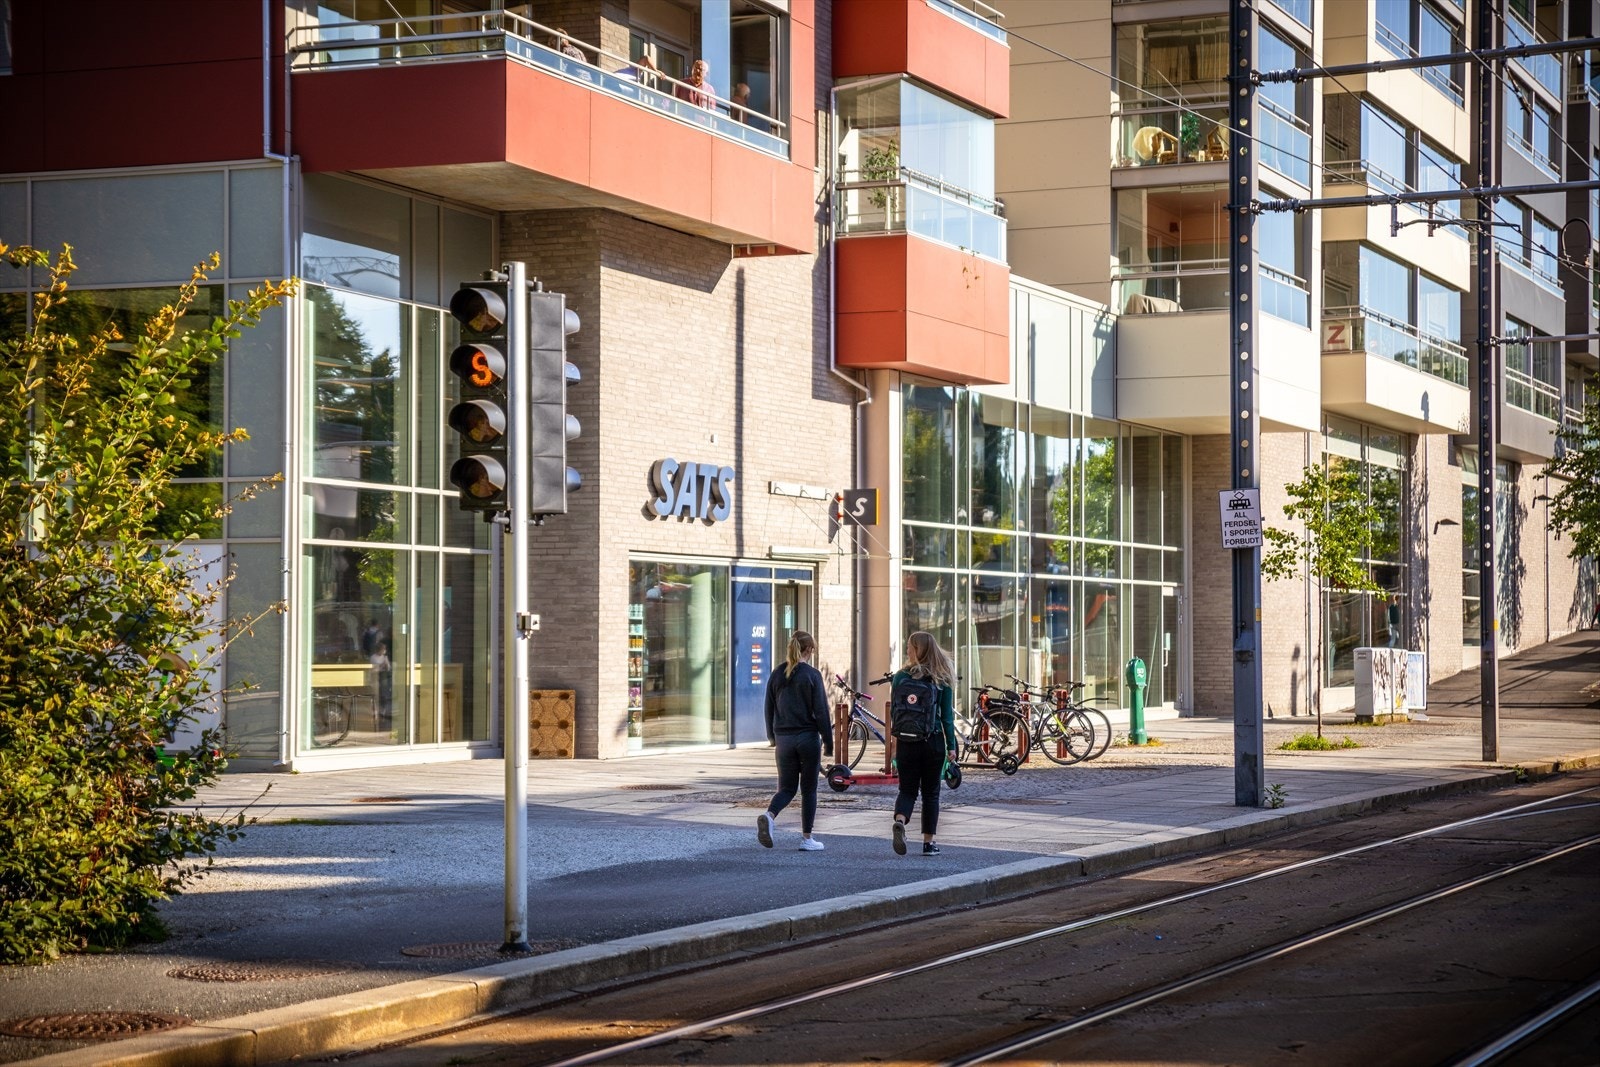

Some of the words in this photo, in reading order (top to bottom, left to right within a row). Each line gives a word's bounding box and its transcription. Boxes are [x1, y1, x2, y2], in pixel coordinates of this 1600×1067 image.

[653, 457, 735, 522] SATS
[851, 497, 868, 517] S
[1224, 520, 1258, 528] FERDSEL
[1229, 528, 1259, 537] SPORET
[1224, 537, 1259, 545] FORBUDT
[751, 625, 766, 638] SATS
